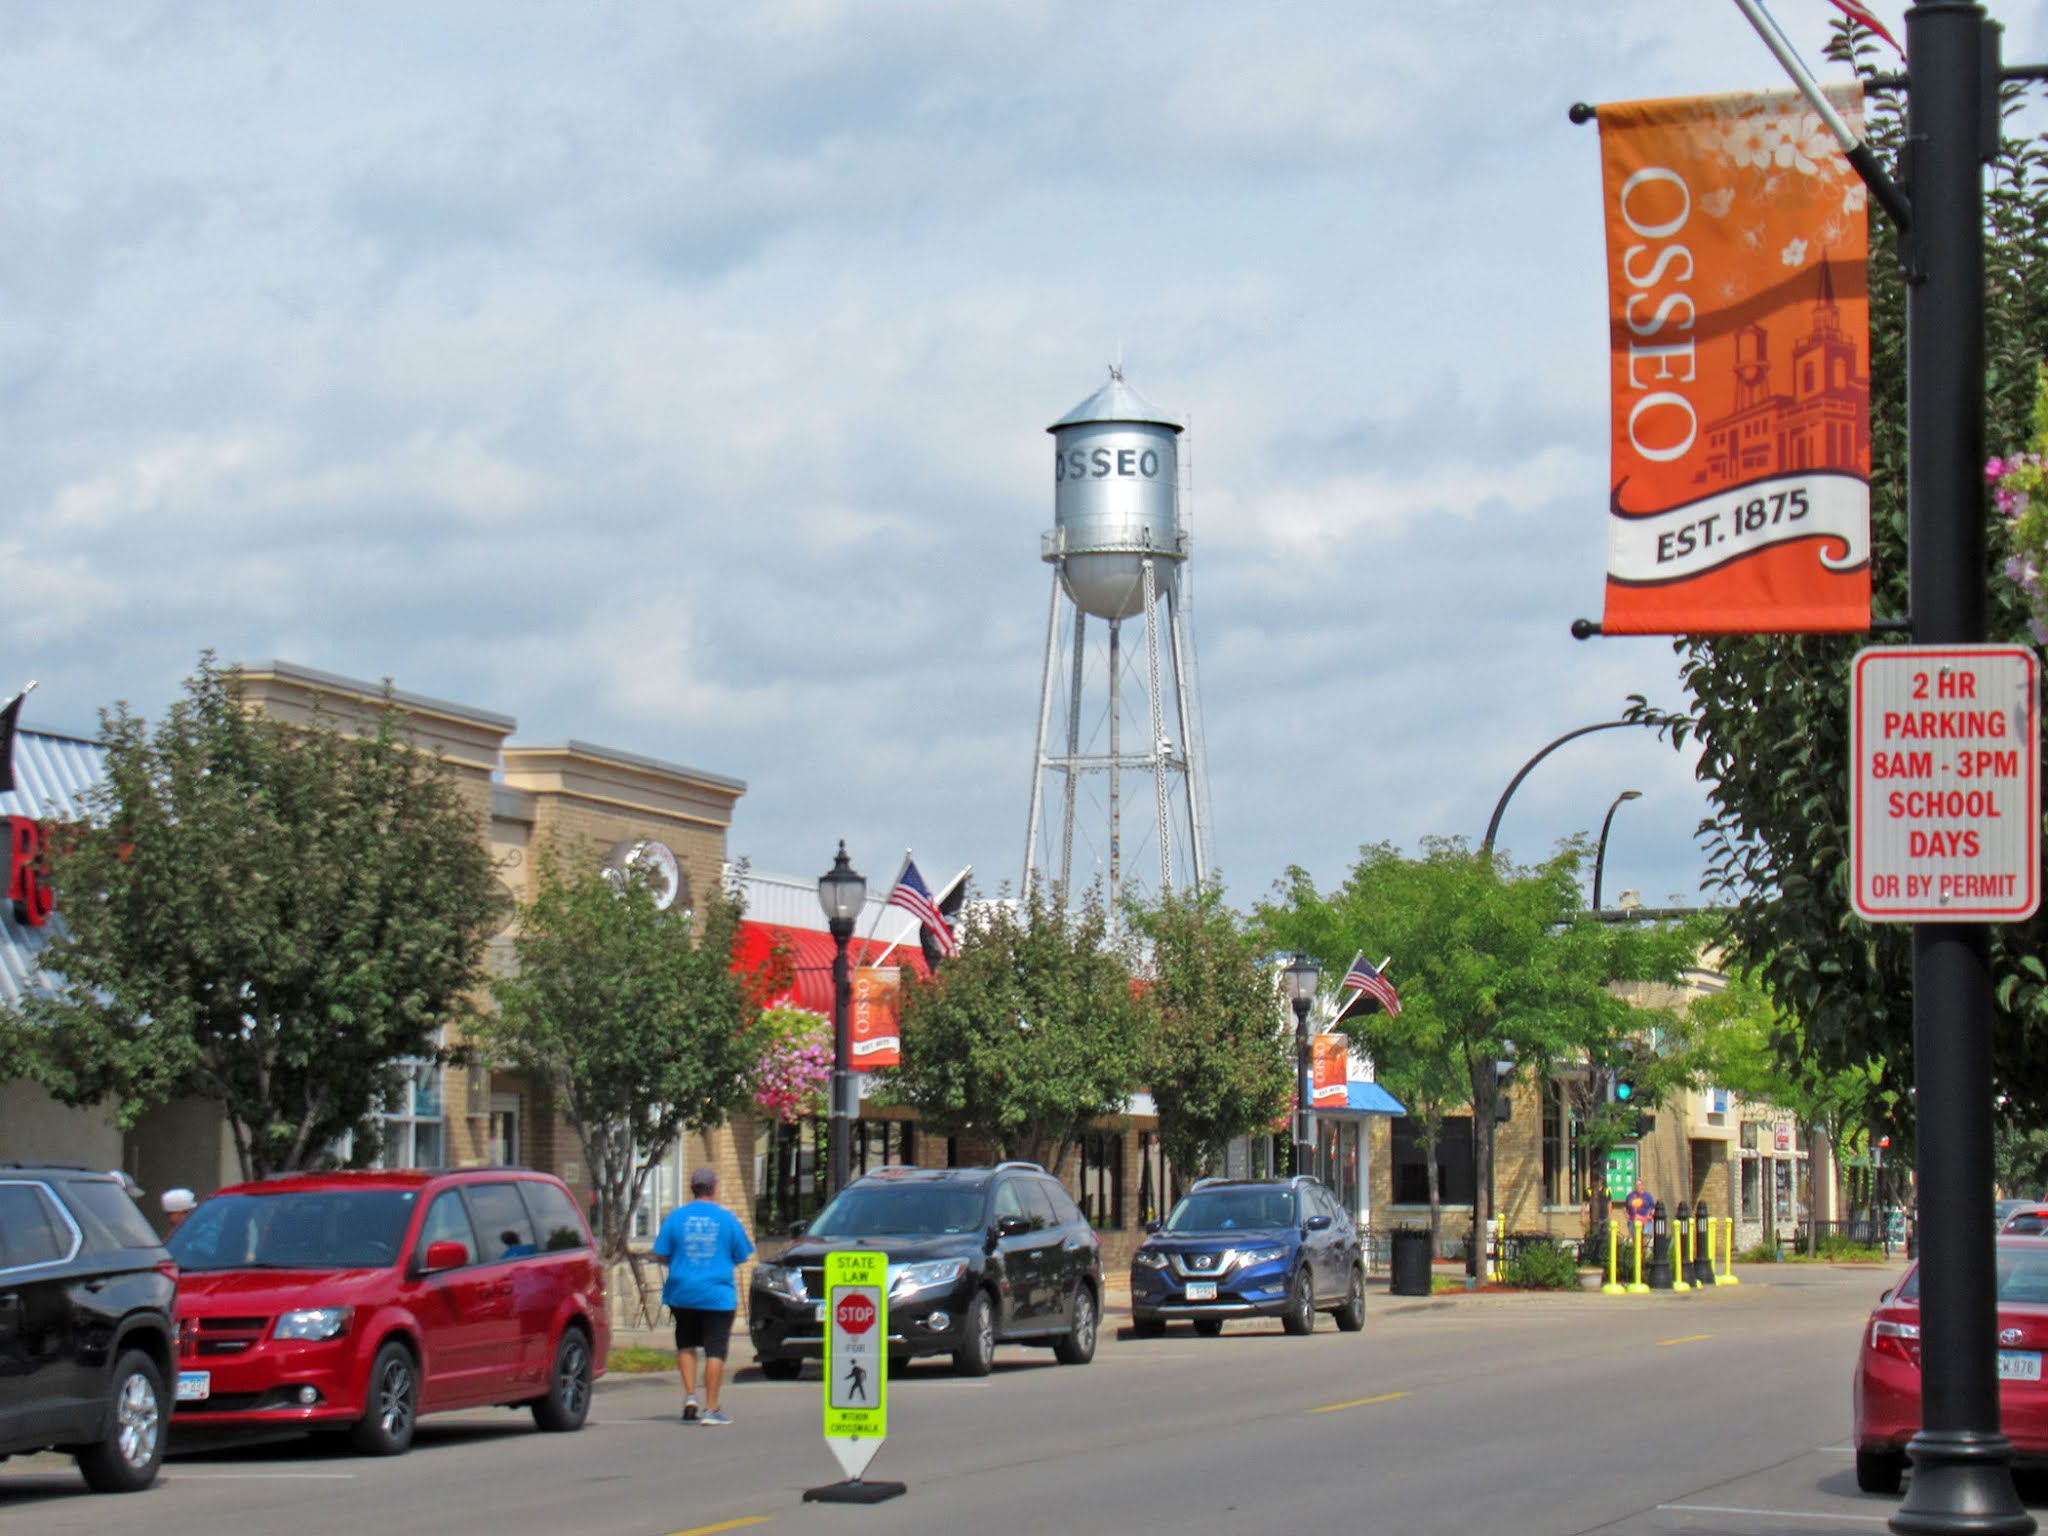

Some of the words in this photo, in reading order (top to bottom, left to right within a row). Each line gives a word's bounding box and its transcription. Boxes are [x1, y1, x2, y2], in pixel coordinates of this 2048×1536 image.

[1620, 166, 1697, 463] OSSEO
[1055, 448, 1160, 482] OSSEO
[1657, 513, 1725, 564] EST.
[1734, 488, 1809, 536] 1875
[1912, 671, 1929, 699] 2
[1937, 671, 1976, 699] HR
[1884, 710, 2006, 739] PARKING
[1872, 752, 1932, 779] 8AM
[1956, 750, 2018, 778] 3PM
[1888, 790, 2001, 818] SCHOOL
[1909, 830, 1980, 858] DAYS
[1872, 875, 1899, 898] OR
[1906, 875, 1932, 898] BY
[1940, 874, 2016, 898] PERMIT
[837, 1256, 875, 1269] STATE
[843, 1271, 869, 1283] LAW
[838, 1306, 873, 1322] STOP
[845, 1343, 866, 1353] FOR
